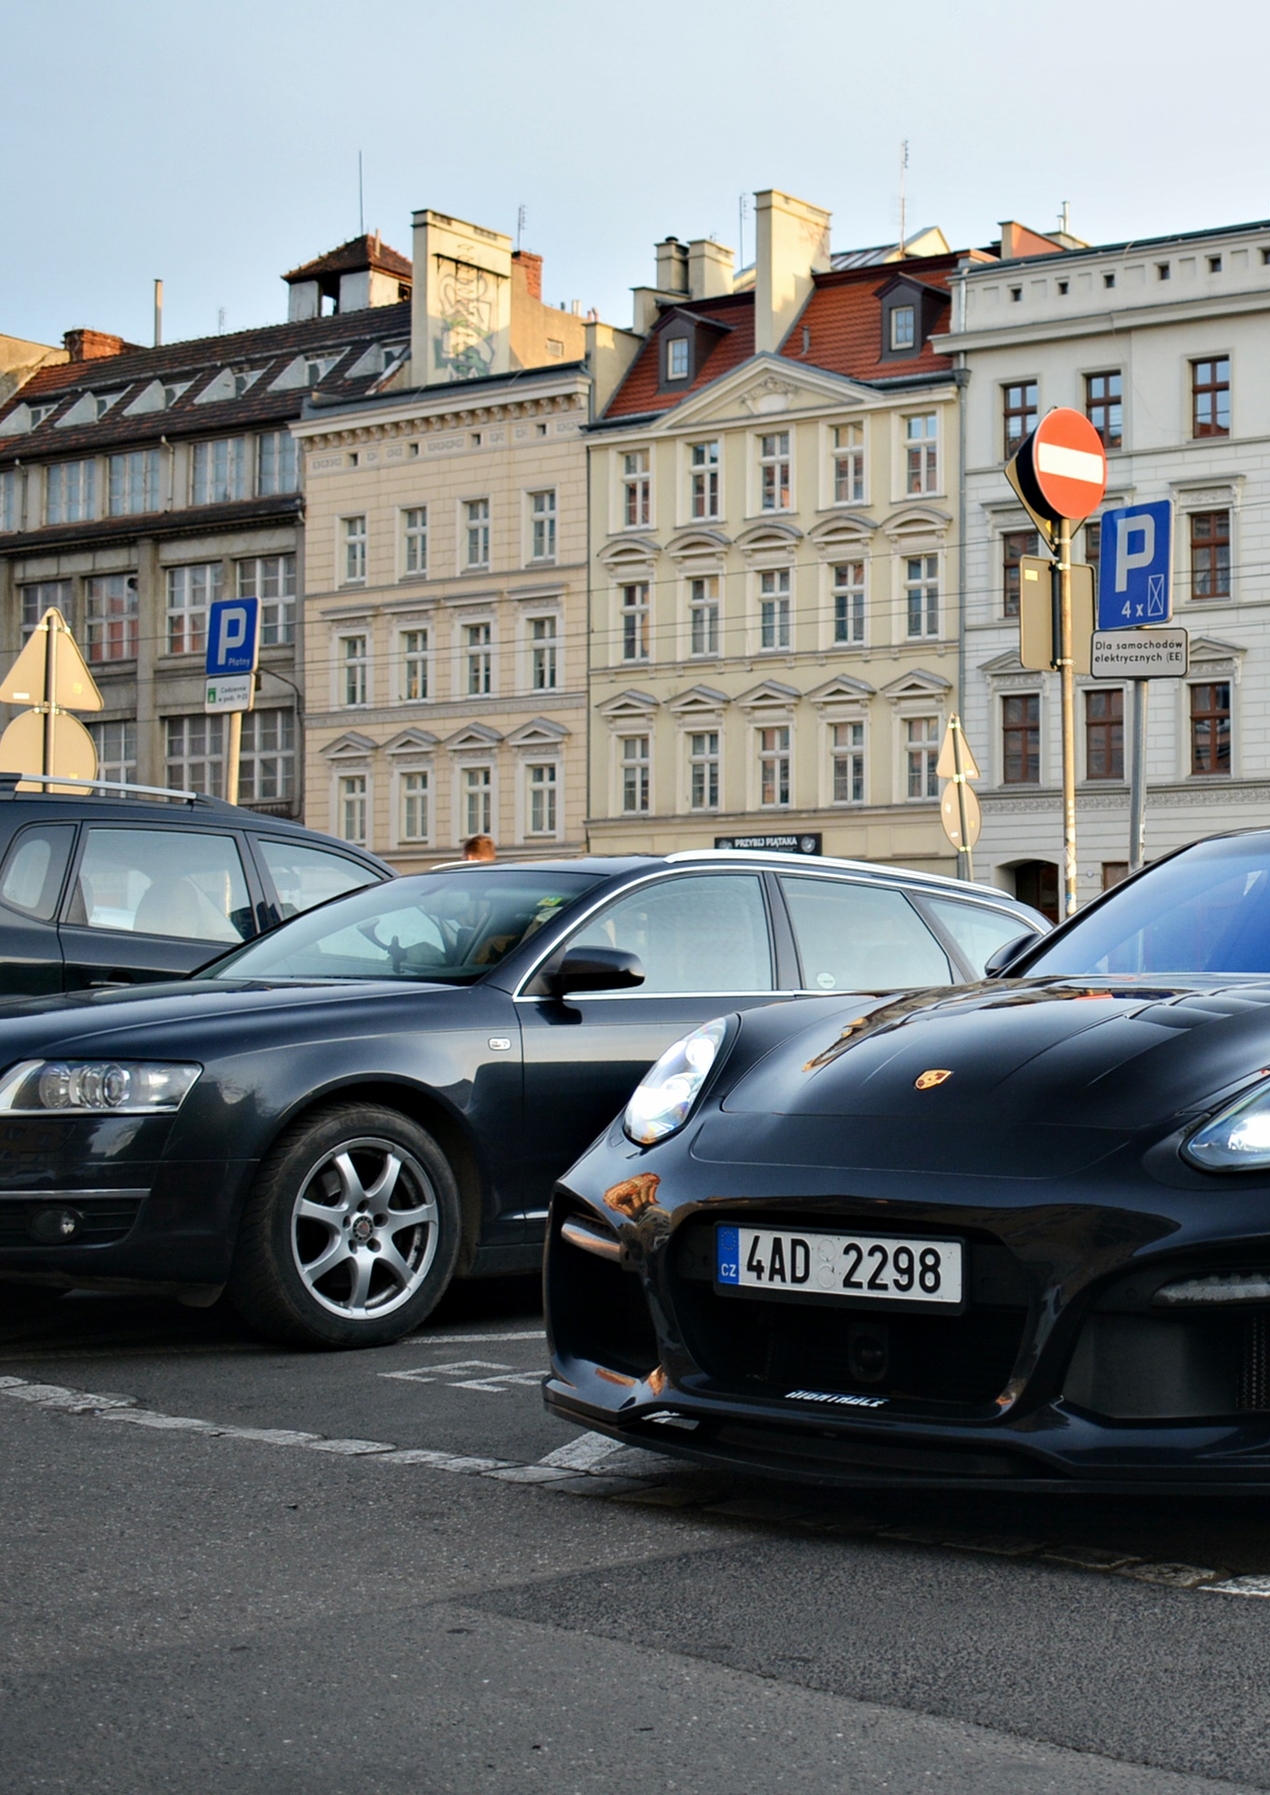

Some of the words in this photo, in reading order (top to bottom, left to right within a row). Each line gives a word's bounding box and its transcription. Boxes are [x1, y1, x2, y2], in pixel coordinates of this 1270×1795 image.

[1115, 513, 1155, 593] P
[1121, 600, 1132, 618] 4
[1135, 603, 1144, 617] x
[217, 607, 247, 666] P
[1095, 641, 1112, 650] Dla
[1116, 639, 1183, 650] samochodów
[1095, 652, 1162, 664] elektrycznych
[1166, 652, 1182, 663] (EE)
[734, 838, 765, 848] PRZYBIJ
[766, 836, 798, 848] PIĄTAKA
[721, 1263, 737, 1277] CZ
[746, 1235, 811, 1284] 4AD
[842, 1243, 942, 1294] 2298
